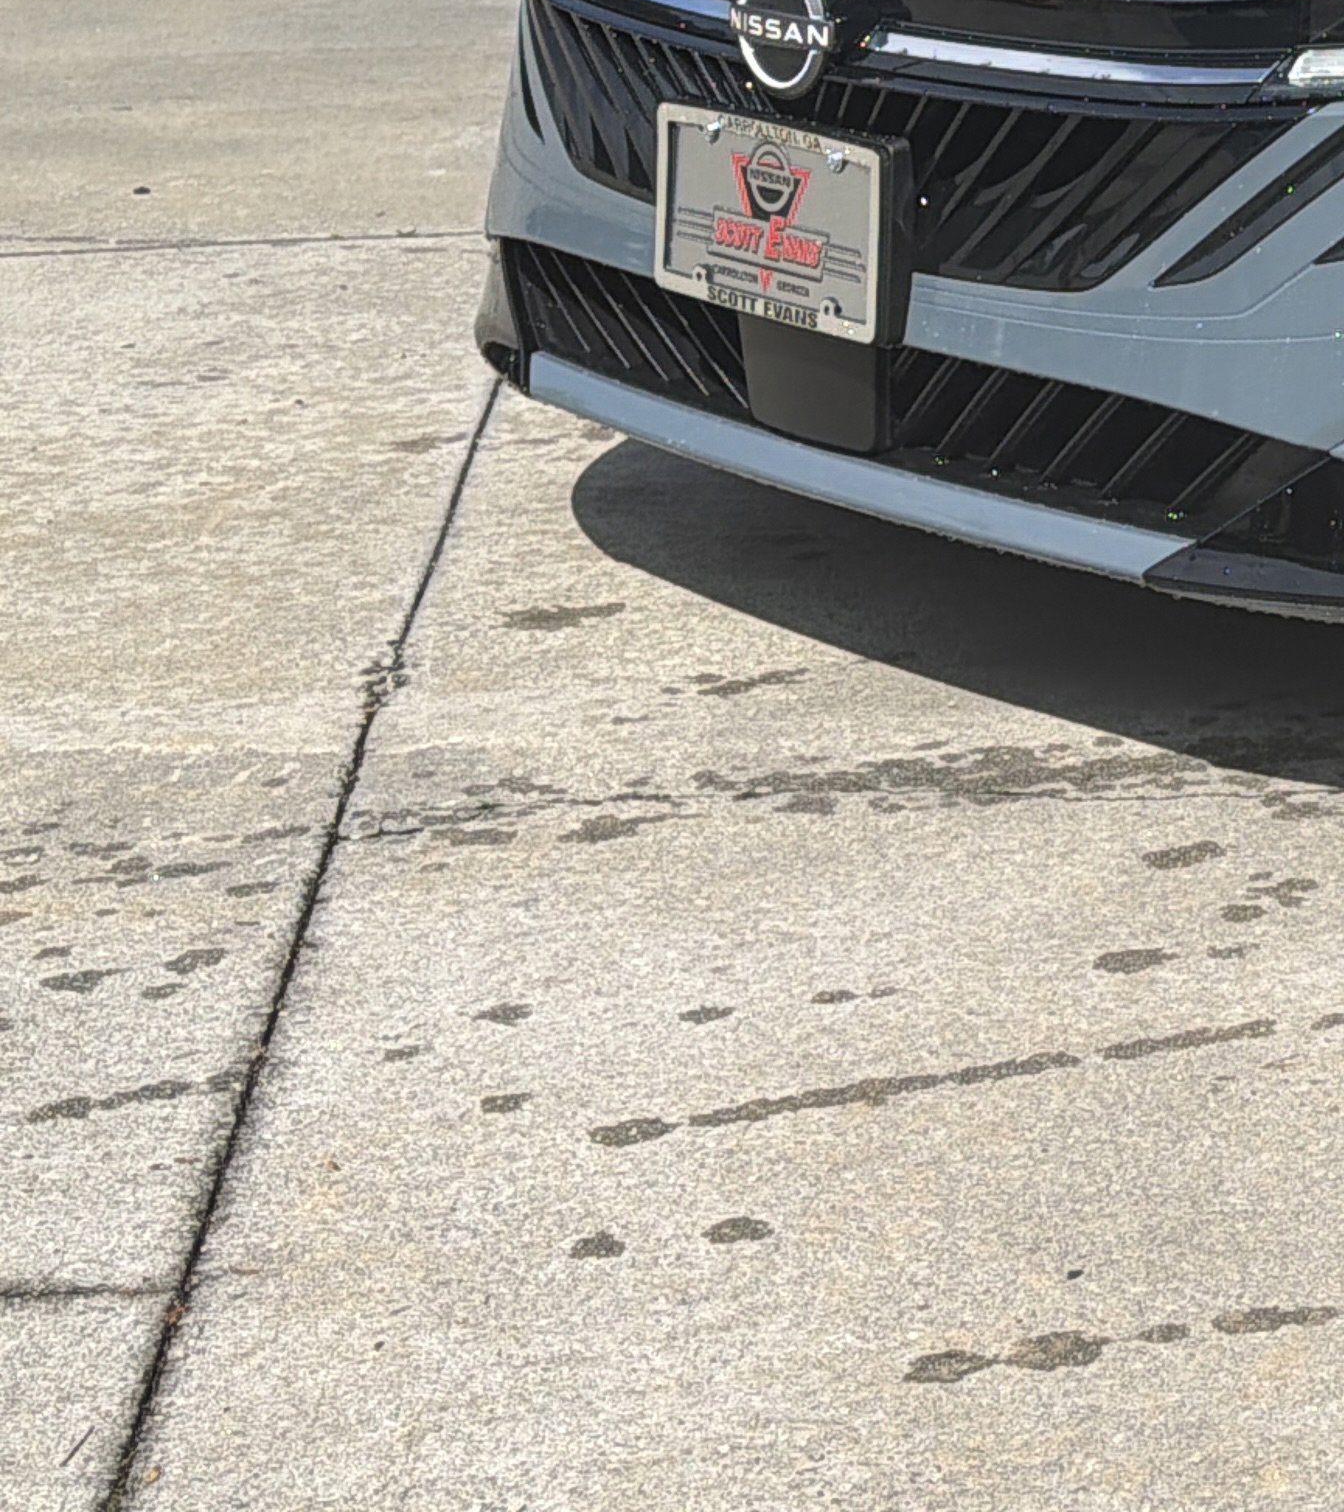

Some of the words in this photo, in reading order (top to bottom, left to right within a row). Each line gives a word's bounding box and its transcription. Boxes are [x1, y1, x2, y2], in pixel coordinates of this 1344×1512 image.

[730, 7, 829, 47] NISSAN
[749, 168, 791, 188] NISSAN
[714, 218, 764, 255] SCOTT
[707, 285, 759, 313] SCOTT
[763, 301, 818, 329] EVANS
